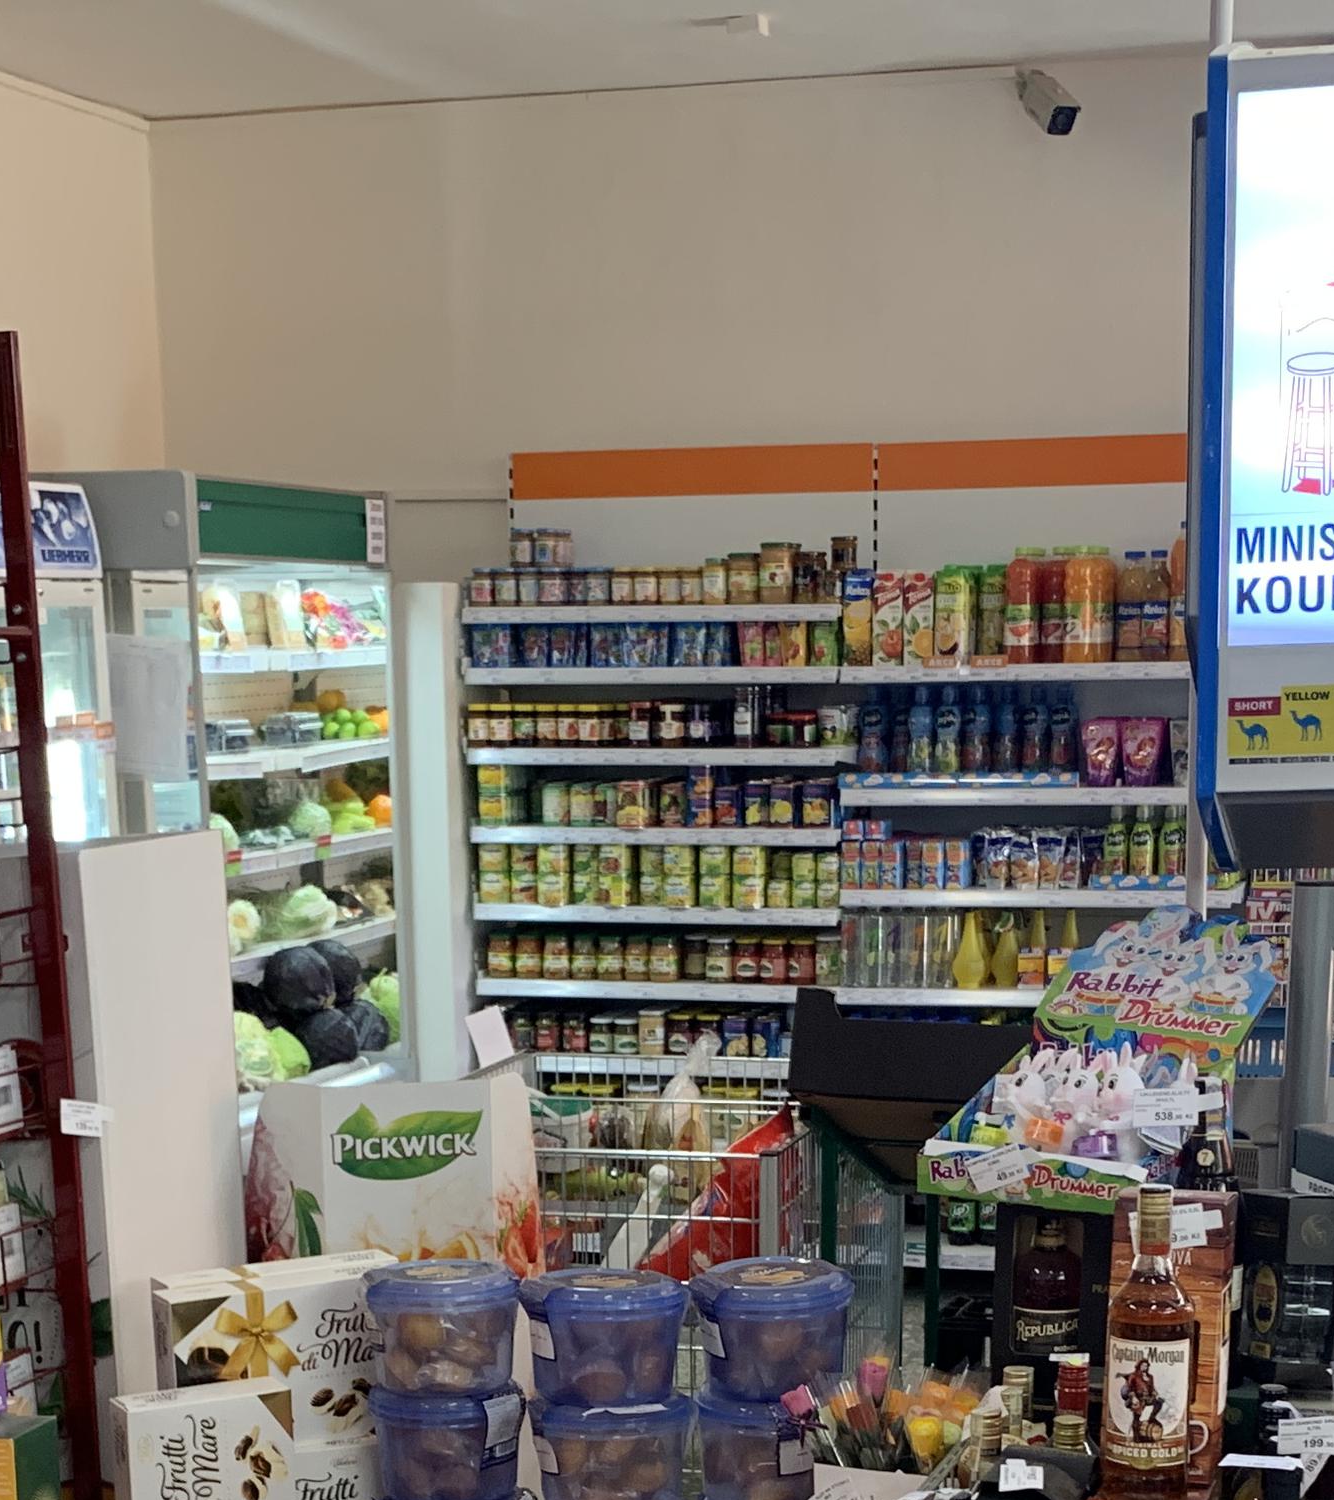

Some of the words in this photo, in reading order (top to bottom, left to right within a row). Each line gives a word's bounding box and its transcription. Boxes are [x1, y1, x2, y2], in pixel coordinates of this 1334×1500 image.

[1283, 690, 1330, 702] YELLOW
[1233, 700, 1274, 713] SHORT
[1065, 969, 1166, 999] Rabbit
[331, 1131, 478, 1165] PICKWICK
[1111, 1345, 1146, 1363] Captain
[1148, 1346, 1185, 1363] Morgan
